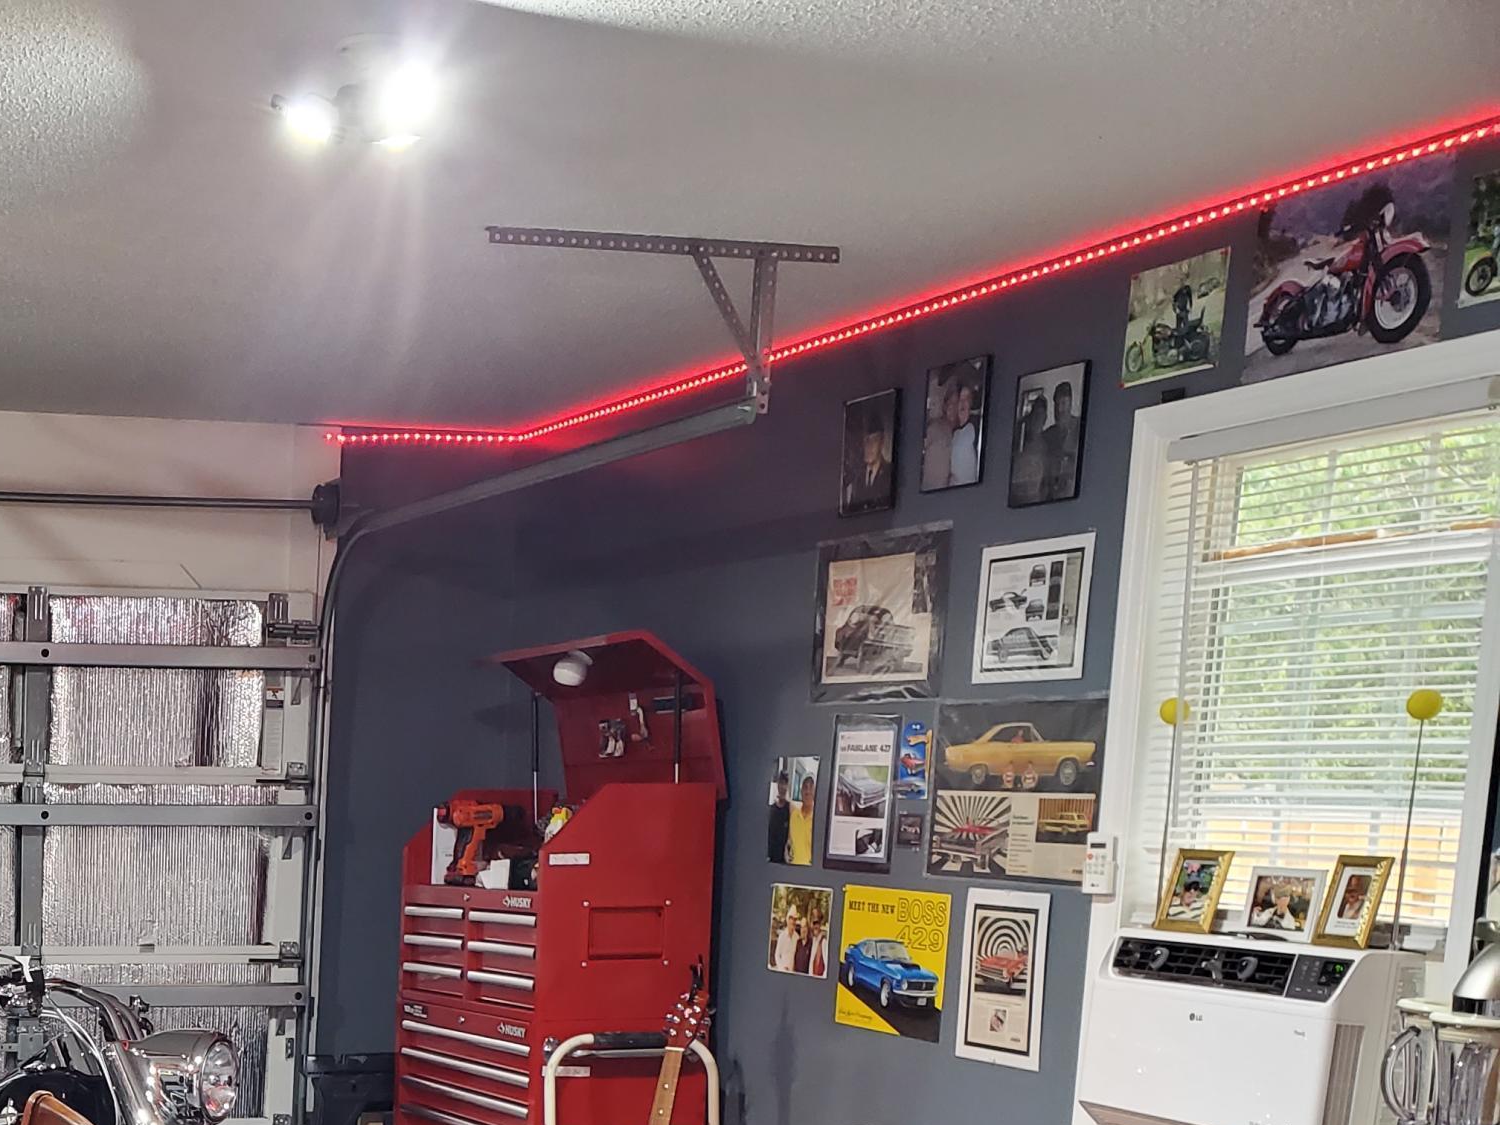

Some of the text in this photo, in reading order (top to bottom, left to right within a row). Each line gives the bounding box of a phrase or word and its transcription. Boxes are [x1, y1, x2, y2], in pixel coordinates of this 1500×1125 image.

[510, 896, 531, 909] HUSKY
[849, 897, 947, 928] MEET THE NEW BOSS
[896, 925, 945, 953] 429
[505, 1023, 526, 1039] HUSKY
